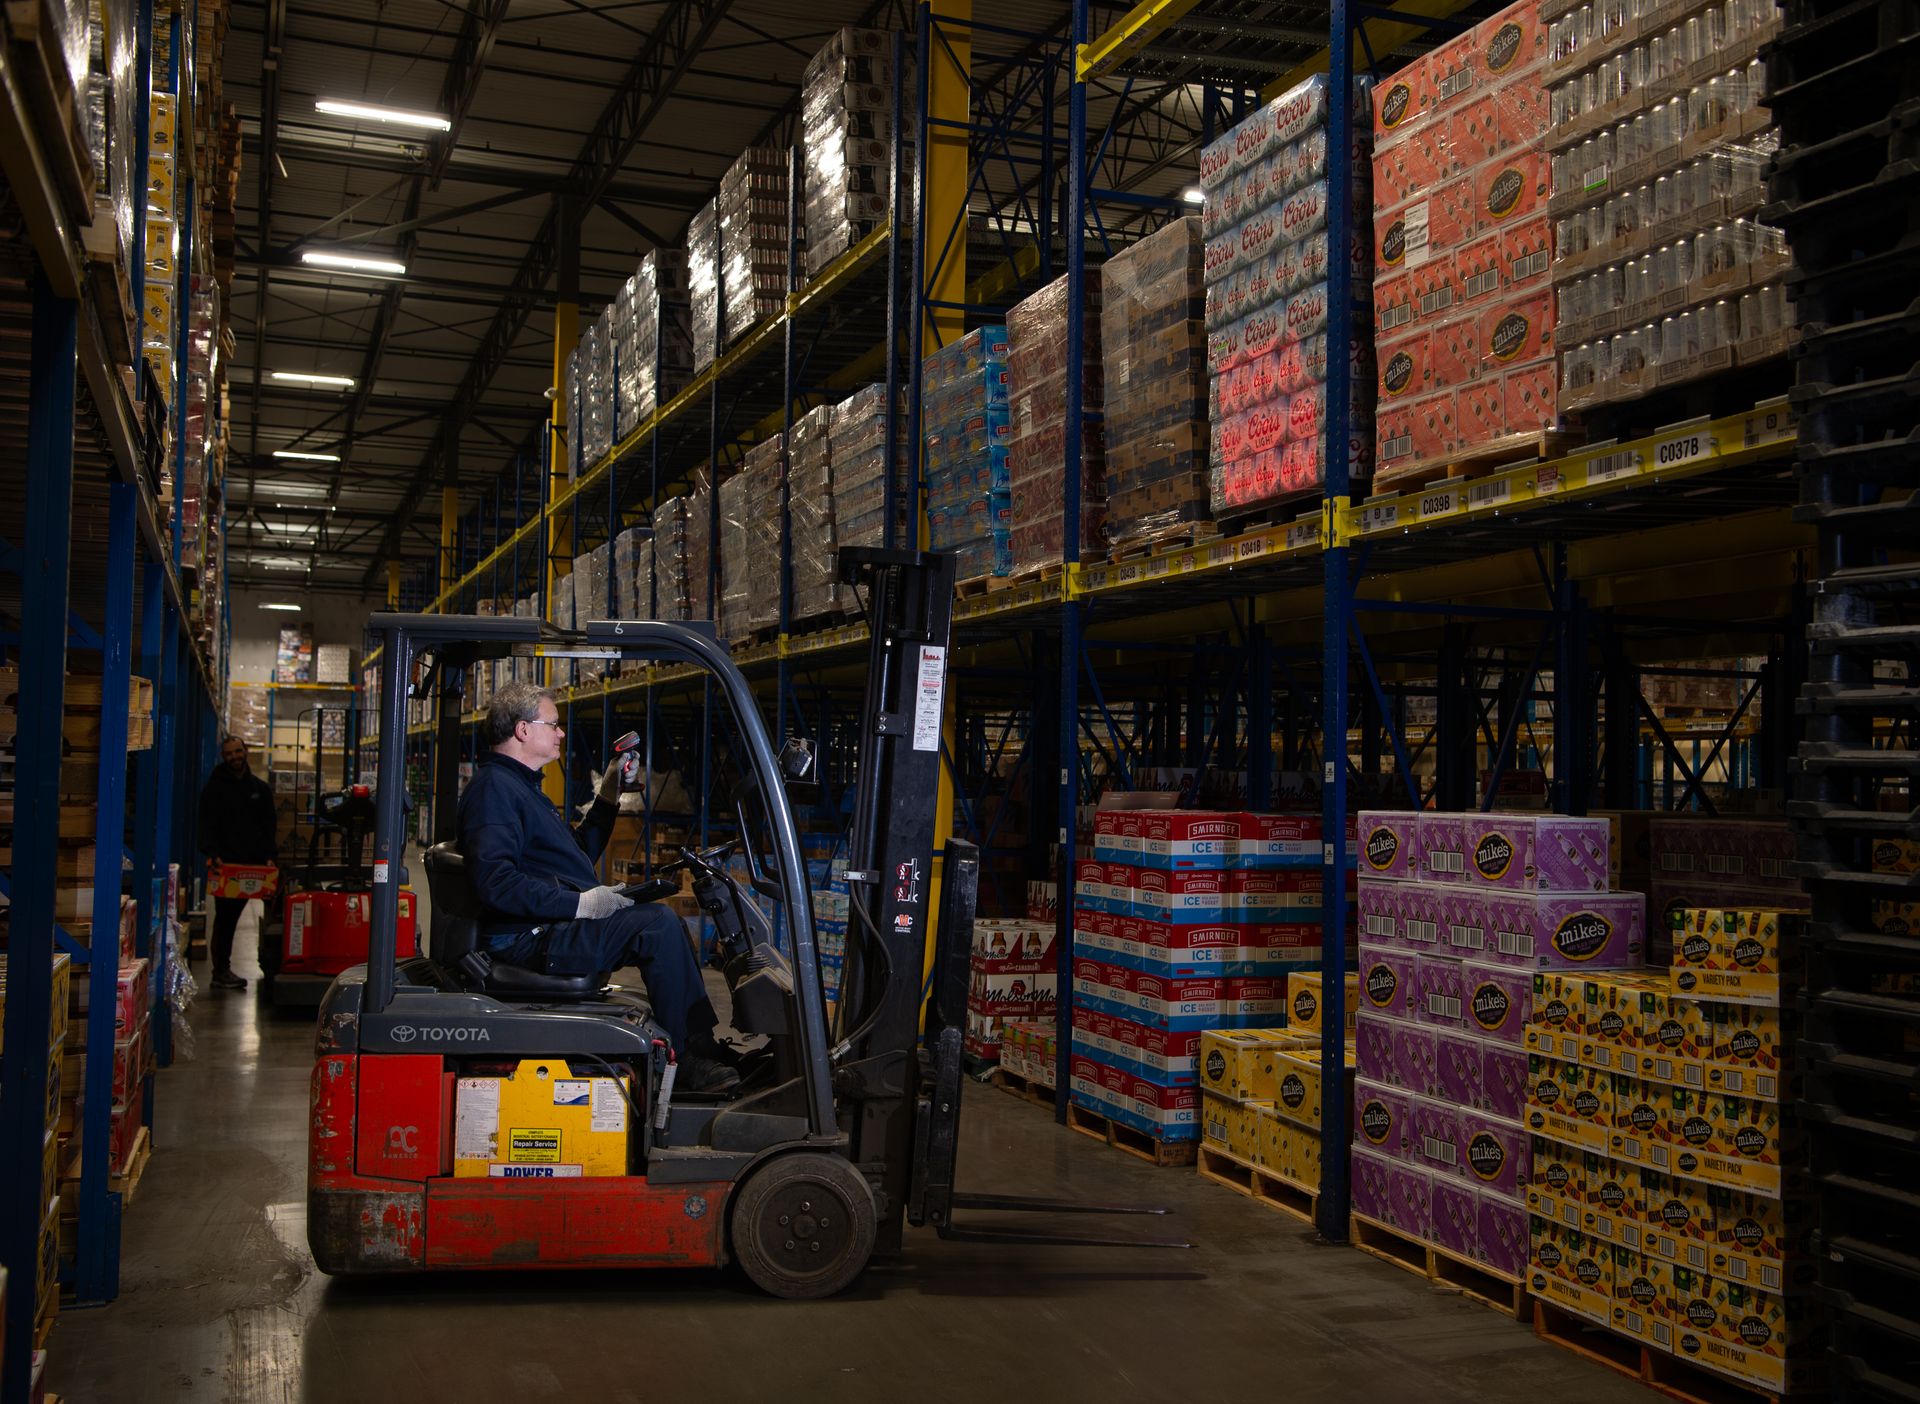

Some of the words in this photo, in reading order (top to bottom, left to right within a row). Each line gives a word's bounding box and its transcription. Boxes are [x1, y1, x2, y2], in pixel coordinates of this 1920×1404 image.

[1487, 26, 1522, 62] mike's
[1277, 94, 1312, 129] Coors
[1383, 89, 1409, 121] mike's
[1284, 120, 1304, 138] LIGHT
[1236, 122, 1268, 156] Coors
[1244, 145, 1262, 163] LIGHT
[1200, 152, 1229, 180] Coors
[1490, 175, 1521, 204] mike's
[1283, 195, 1318, 229] Coors
[1241, 218, 1275, 251] Coors
[1291, 220, 1311, 237] LIGHT
[1249, 241, 1268, 258] LIGHT
[1206, 243, 1236, 271] Coors
[1287, 294, 1323, 327] Coors
[1245, 317, 1277, 346] Coors
[1296, 319, 1315, 336] LIGHT
[1493, 319, 1526, 348] mike's
[1208, 334, 1238, 362] Crs
[1252, 338, 1270, 354] LIGHT
[1386, 358, 1411, 382] mike's
[1248, 413, 1281, 440] Coors
[1255, 434, 1274, 448] LIGHT
[1660, 438, 1699, 464] C037B
[1422, 498, 1450, 515] C039B
[1240, 538, 1261, 555] C041B
[1192, 822, 1237, 835] SMIRNOFF
[1272, 828, 1299, 837] SMIRNOFF
[1192, 843, 1212, 853] ICE
[1268, 843, 1285, 852] ICE
[1369, 834, 1395, 855] mike's
[1477, 843, 1510, 864] mike's
[1187, 882, 1216, 890] SMIRNOFF
[1184, 896, 1200, 905] ICE
[1242, 896, 1260, 905] ICE
[1298, 895, 1314, 904] ICE
[894, 914, 913, 927] AMC
[1192, 931, 1236, 943] SMIRNOFF
[1271, 936, 1298, 944] SMIRNOFF
[1560, 921, 1607, 945] mike's
[1267, 950, 1283, 959] ICE
[1684, 941, 1710, 954] mike's
[1735, 944, 1762, 957] mike's
[1192, 950, 1212, 960] ICE
[1369, 975, 1395, 991] mike's
[1702, 973, 1726, 986] VARIETY
[1726, 975, 1742, 987] PACK
[1184, 989, 1213, 998] SMIRNOFF
[1243, 989, 1270, 997] SMIRNOFF
[1180, 1004, 1197, 1013] ICE
[1240, 1003, 1255, 1011] ICE
[1296, 996, 1316, 1012] mike's
[1475, 993, 1506, 1013] mike's
[1546, 1007, 1568, 1018] mike's
[1600, 1018, 1623, 1030] mike's
[419, 1028, 491, 1041] TOYOTA
[1660, 1026, 1683, 1039] mike's
[1733, 1036, 1759, 1049] mike's
[1207, 1057, 1225, 1070] mike's
[1282, 1084, 1304, 1099] mike's
[1537, 1086, 1559, 1097] mike's
[1576, 1098, 1599, 1109] mike's
[1175, 1112, 1191, 1121] ICE
[1364, 1111, 1390, 1126] mike's
[1633, 1111, 1657, 1122] mike's
[1550, 1117, 1566, 1129] VARIETY
[1566, 1122, 1578, 1132] PACK
[1685, 1123, 1711, 1136] mike's
[514, 1140, 534, 1148] Repair
[1737, 1133, 1765, 1146] mike's
[1471, 1146, 1501, 1161] mike's
[1703, 1157, 1727, 1172] VARIETY
[1727, 1163, 1743, 1175] PACK
[1547, 1169, 1569, 1181] mike's
[1602, 1189, 1624, 1200] mike's
[1664, 1205, 1689, 1219] mike's
[1735, 1225, 1762, 1239] mike's
[1538, 1249, 1561, 1260] mike's
[1578, 1264, 1601, 1277] mike's
[1551, 1280, 1568, 1296] VARIETY
[1568, 1288, 1581, 1302] PACK
[1632, 1284, 1656, 1296] mike's
[1689, 1307, 1716, 1320] mike's
[1741, 1324, 1770, 1337] mike's
[1706, 1340, 1731, 1358] VARIETY
[1731, 1349, 1747, 1365] PACK
